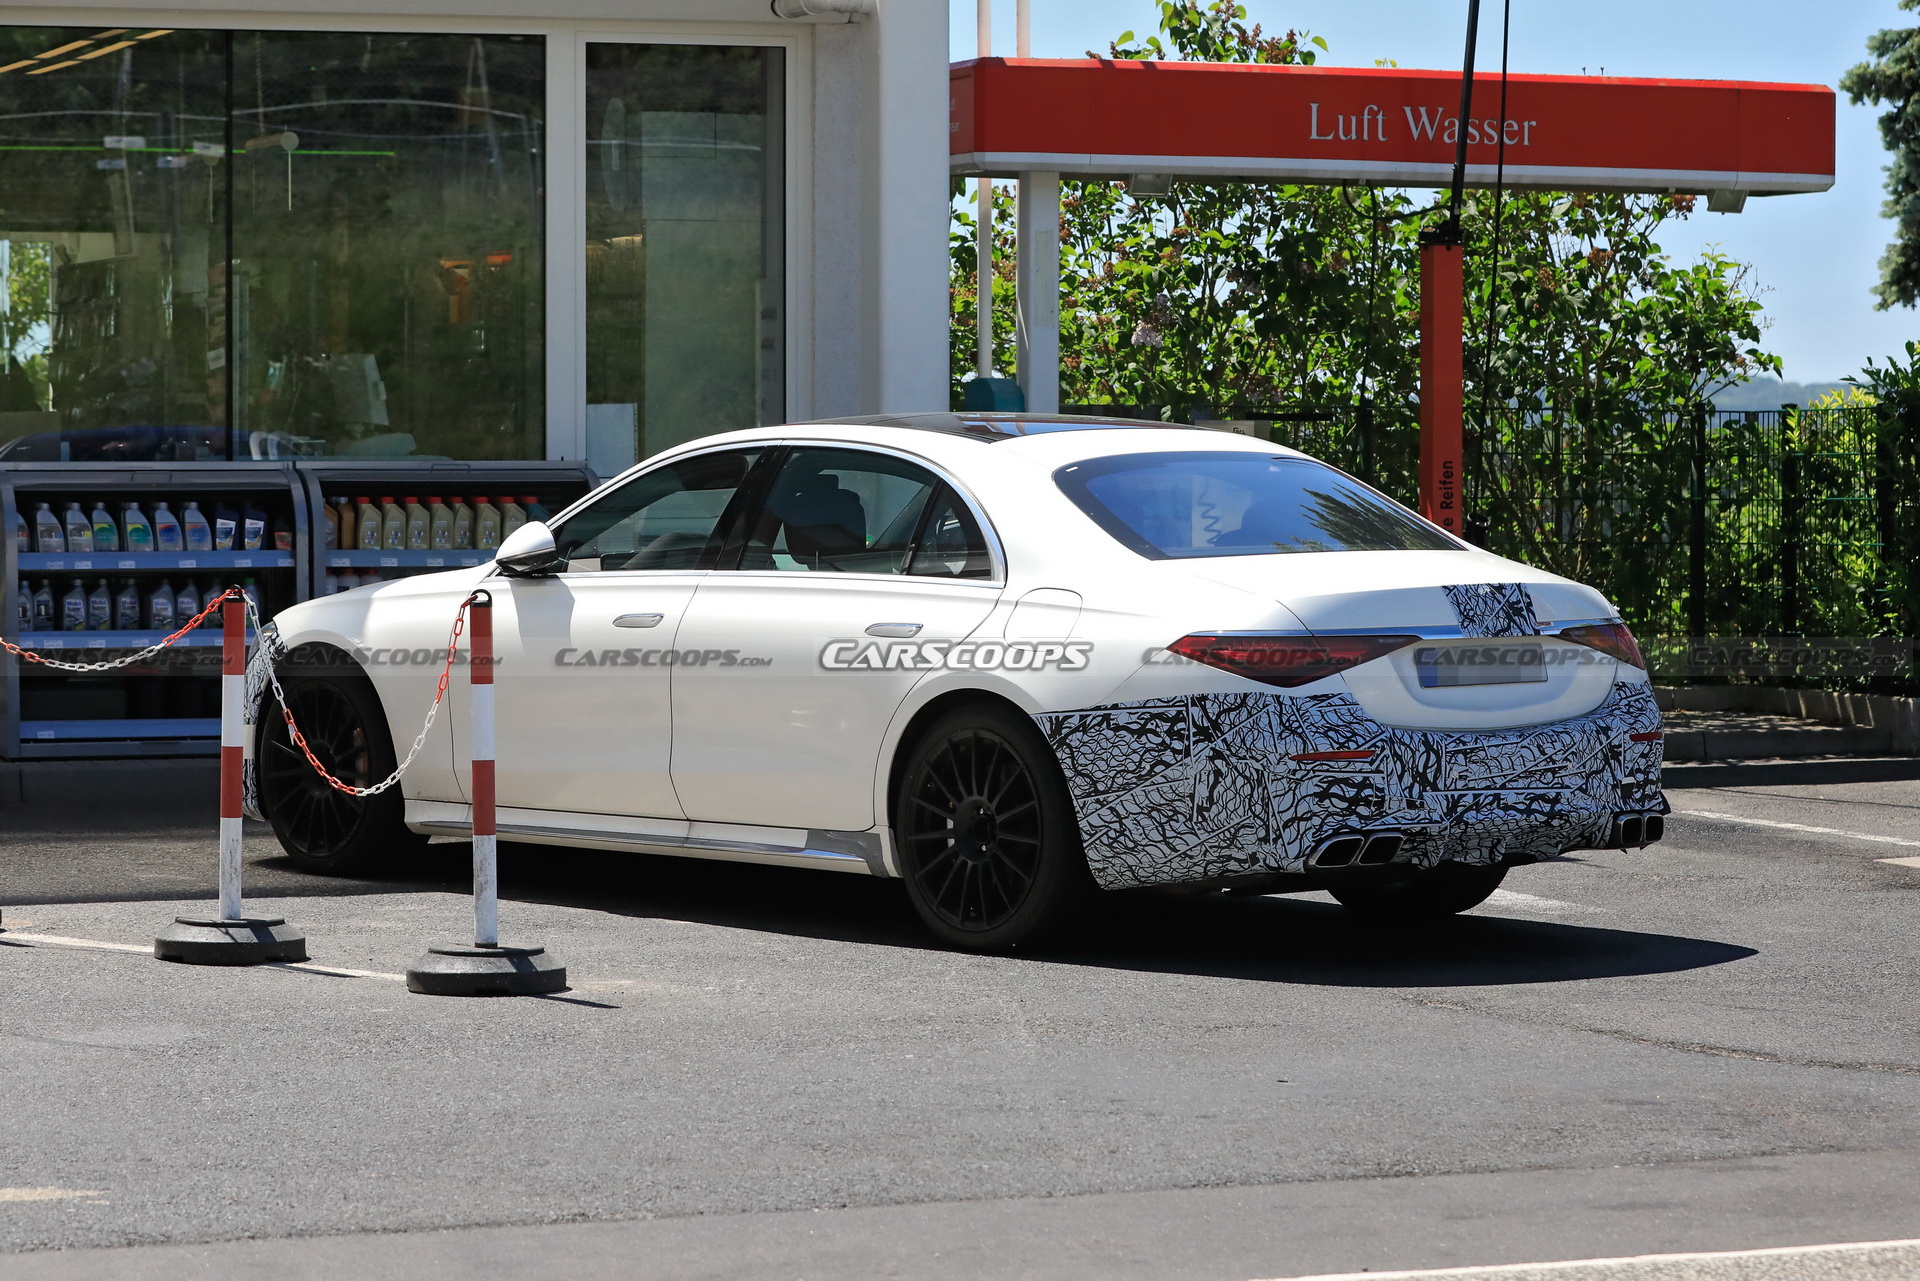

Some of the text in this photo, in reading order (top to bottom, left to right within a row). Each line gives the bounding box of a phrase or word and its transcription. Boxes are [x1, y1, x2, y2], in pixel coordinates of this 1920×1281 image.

[1309, 102, 1537, 146] Luft Wasser
[1439, 460, 1454, 510] Reifen
